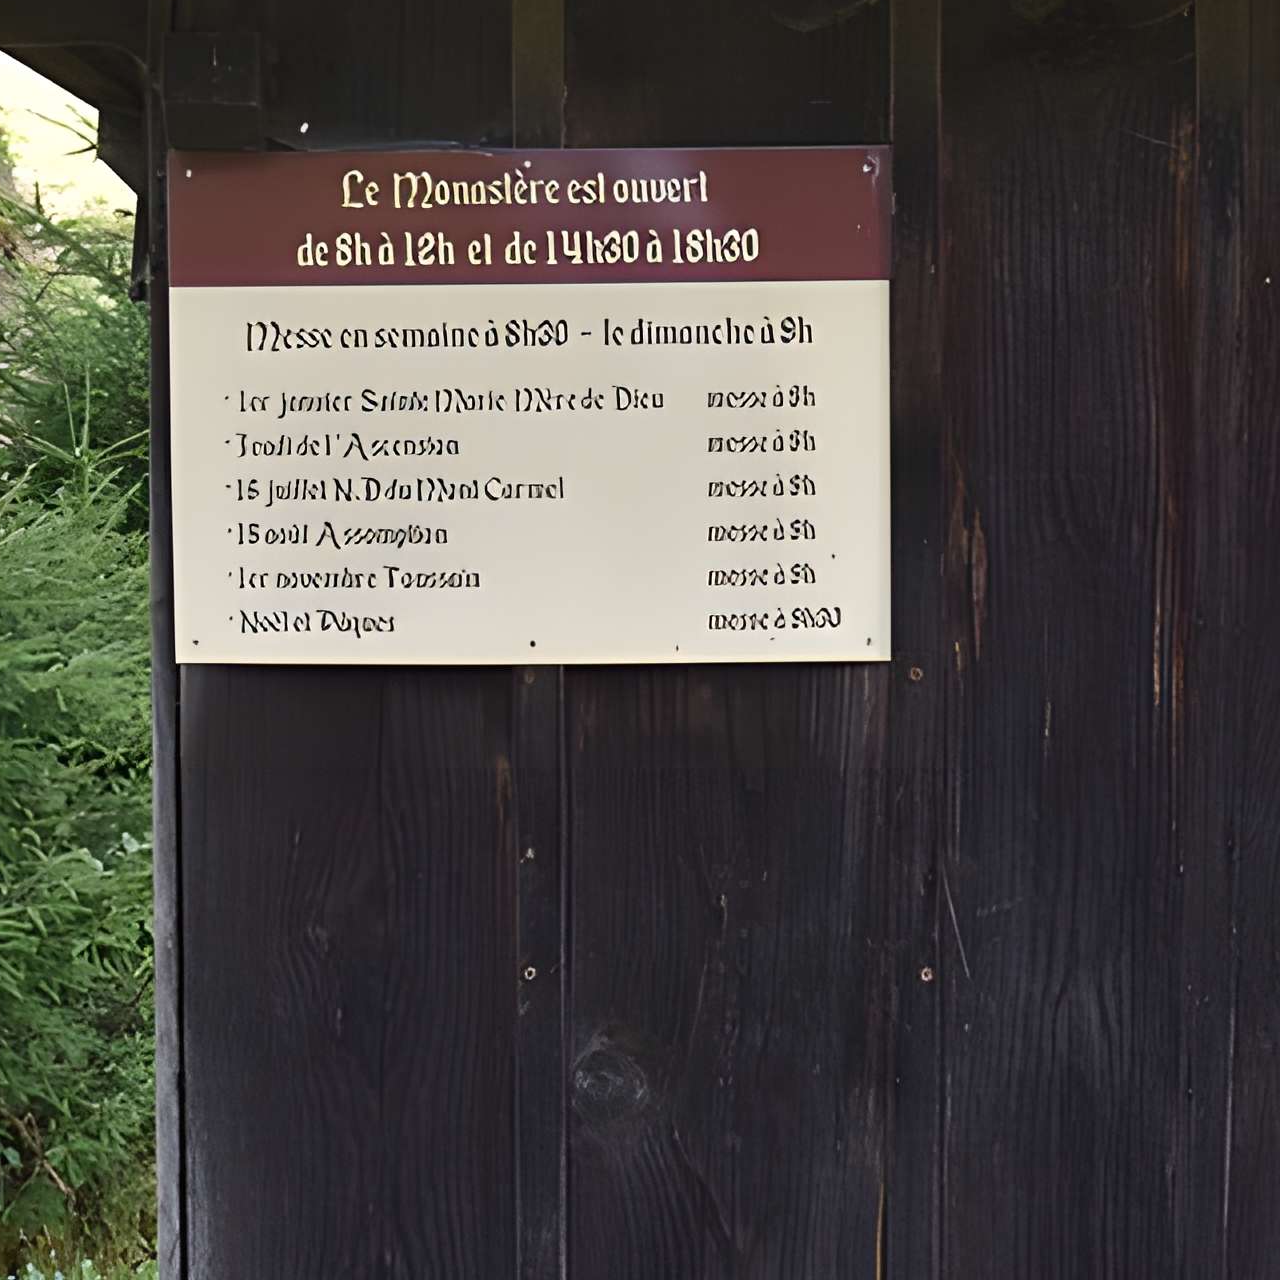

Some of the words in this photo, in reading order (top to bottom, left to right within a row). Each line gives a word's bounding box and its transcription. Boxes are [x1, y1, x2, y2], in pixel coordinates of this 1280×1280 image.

[341, 170, 379, 208] Le
[393, 169, 560, 209] Monastère
[567, 172, 605, 205] est
[613, 170, 708, 205] ouvert
[297, 233, 328, 267] de
[334, 231, 372, 266] 8h
[377, 232, 395, 266] à
[405, 231, 455, 267] 12h
[467, 233, 492, 266] et
[504, 230, 537, 265] de
[546, 229, 640, 265] 14h30
[645, 229, 663, 263] à
[672, 227, 759, 264] 18h30
[246, 321, 333, 352] Messe
[339, 328, 368, 349] en
[374, 322, 480, 349] semaine
[484, 320, 499, 348] à
[504, 319, 569, 348] 8h30
[603, 318, 624, 347] le
[630, 318, 755, 346] dimanche
[760, 316, 776, 345] à
[780, 316, 813, 345] 9h
